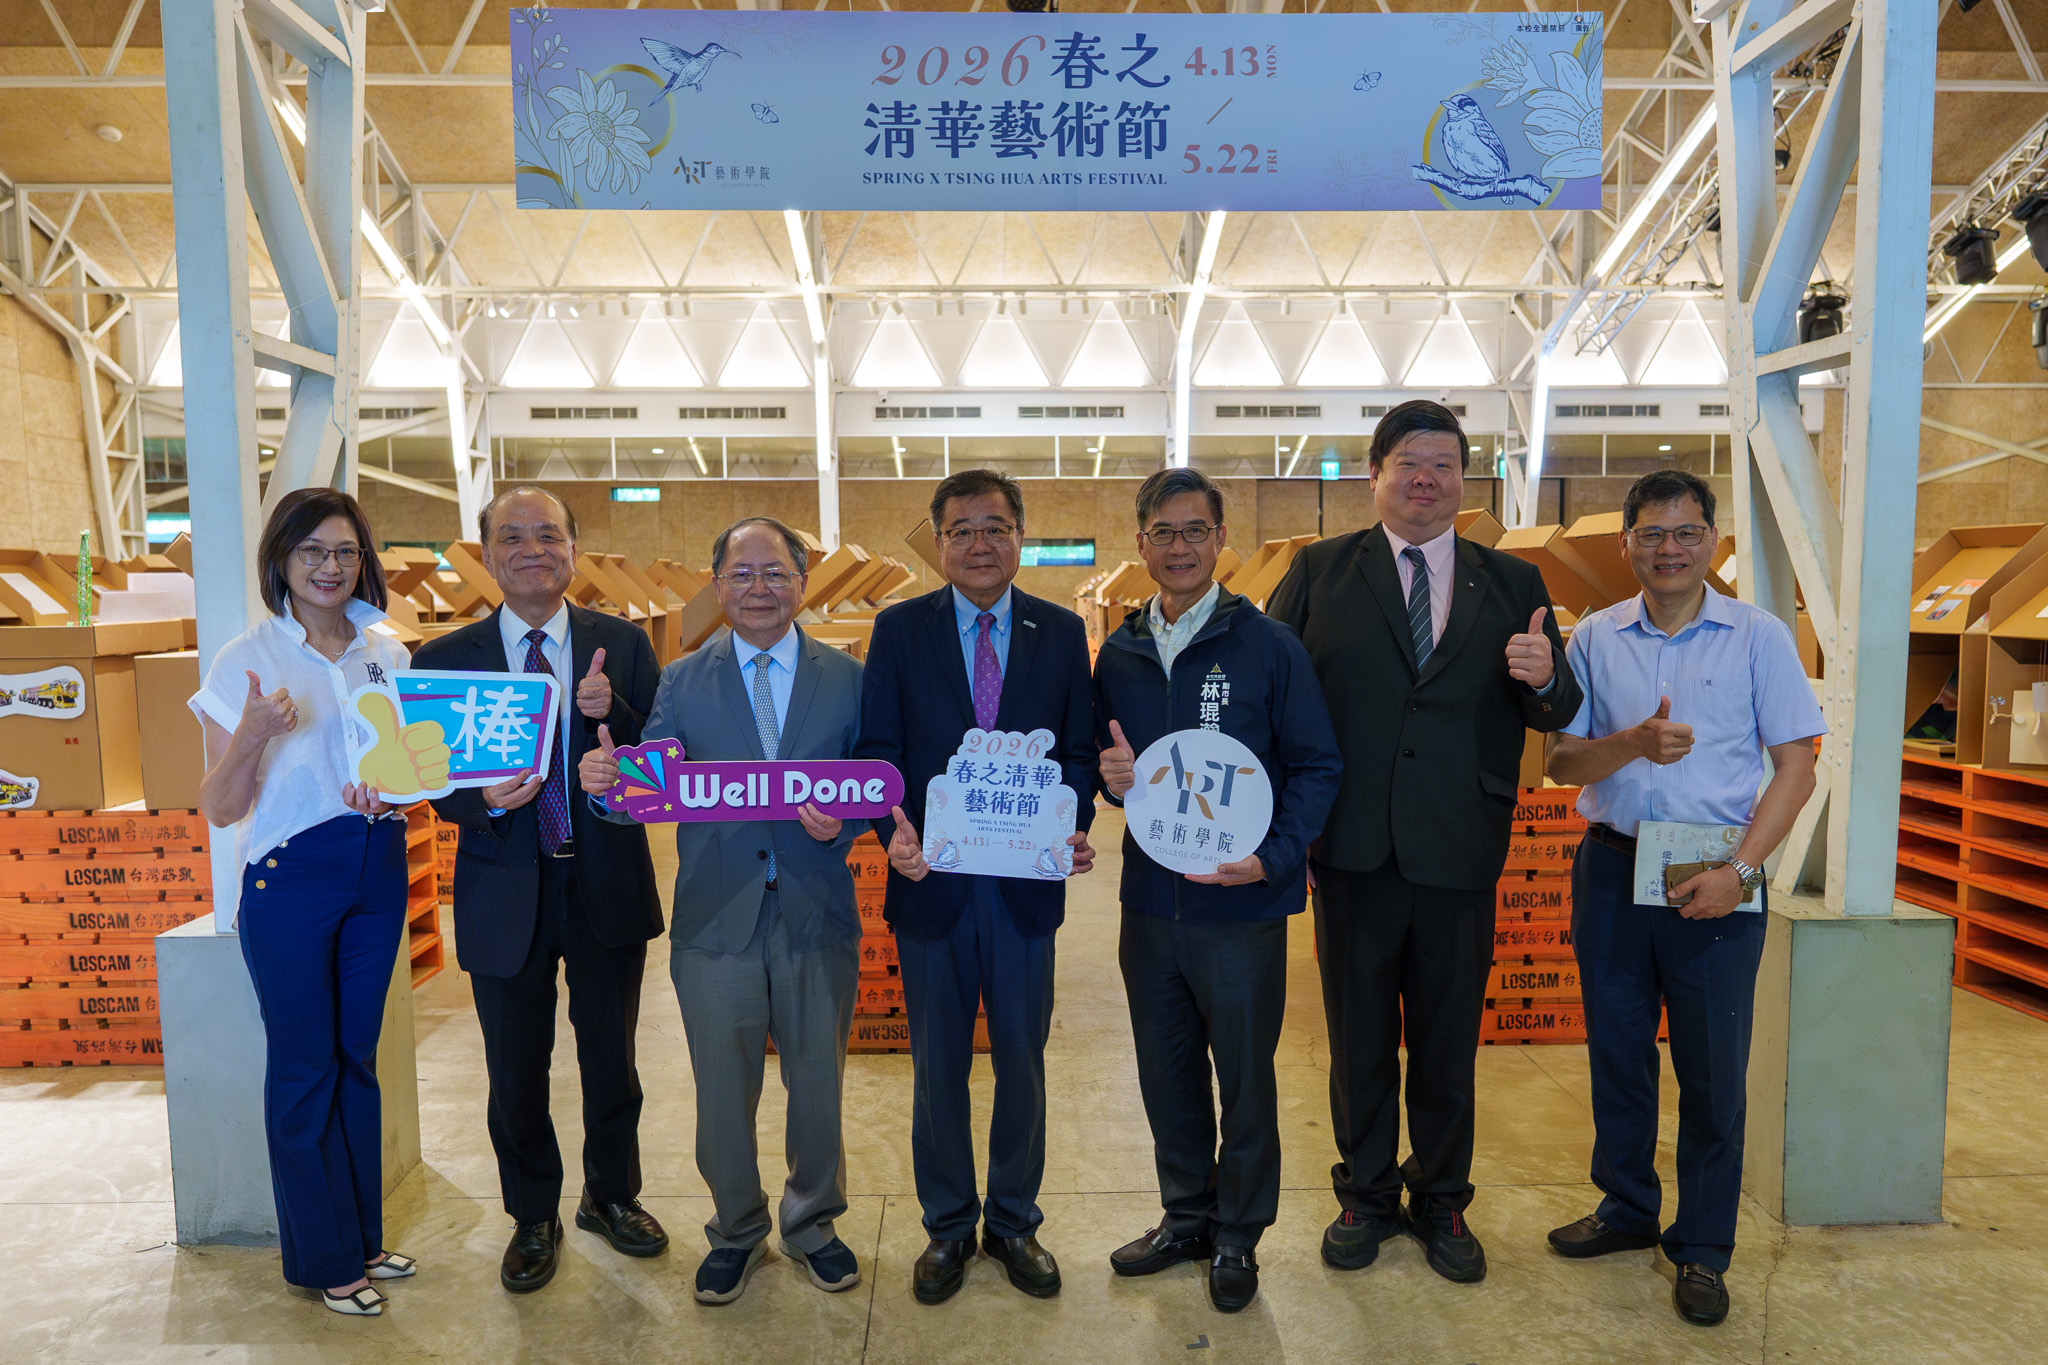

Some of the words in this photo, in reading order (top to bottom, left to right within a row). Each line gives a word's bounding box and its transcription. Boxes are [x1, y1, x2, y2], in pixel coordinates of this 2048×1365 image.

[871, 35, 1046, 86] 2026
[1050, 31, 1171, 89] 春之
[1184, 45, 1260, 77] 4.13
[1266, 44, 1278, 79] MON
[864, 99, 1171, 160] 清華藝術節
[1181, 143, 1261, 174] 5.22
[1267, 149, 1278, 173] FRI
[673, 155, 713, 185] ART
[715, 165, 770, 180] 藝術學院
[862, 172, 925, 185] SPRING
[930, 172, 940, 185] X
[944, 172, 995, 185] TSING
[1001, 172, 1035, 185] HUA
[1039, 172, 1082, 185] ARTS
[1088, 172, 1168, 185] FESTIVAL
[1221, 682, 1231, 706] 副市長
[450, 685, 534, 762] 棒
[964, 734, 1049, 759] 2026
[952, 759, 1056, 790] 春之清華
[1148, 740, 1257, 821] ART
[679, 773, 769, 808] Well
[783, 770, 885, 804] Done
[964, 788, 1041, 818] 藝術節
[59, 826, 120, 844] LOSCAM
[994, 827, 1024, 835] FESTIVAL
[1148, 819, 1235, 854] 藝術學院
[961, 835, 985, 847] 4.13
[1007, 839, 1032, 851] 5.22
[1154, 846, 1188, 858] COLLEGE
[1190, 852, 1200, 860] OF
[1202, 855, 1223, 865] ARTS
[65, 868, 126, 885] LOSCAM
[1503, 891, 1562, 908] LOSCAM
[69, 912, 130, 929] LOSCAM
[69, 954, 131, 972] LOSCAM
[1501, 972, 1559, 990] LOSCAM
[79, 996, 140, 1014] LOSCAM
[1497, 1013, 1555, 1030] LOSCAM
